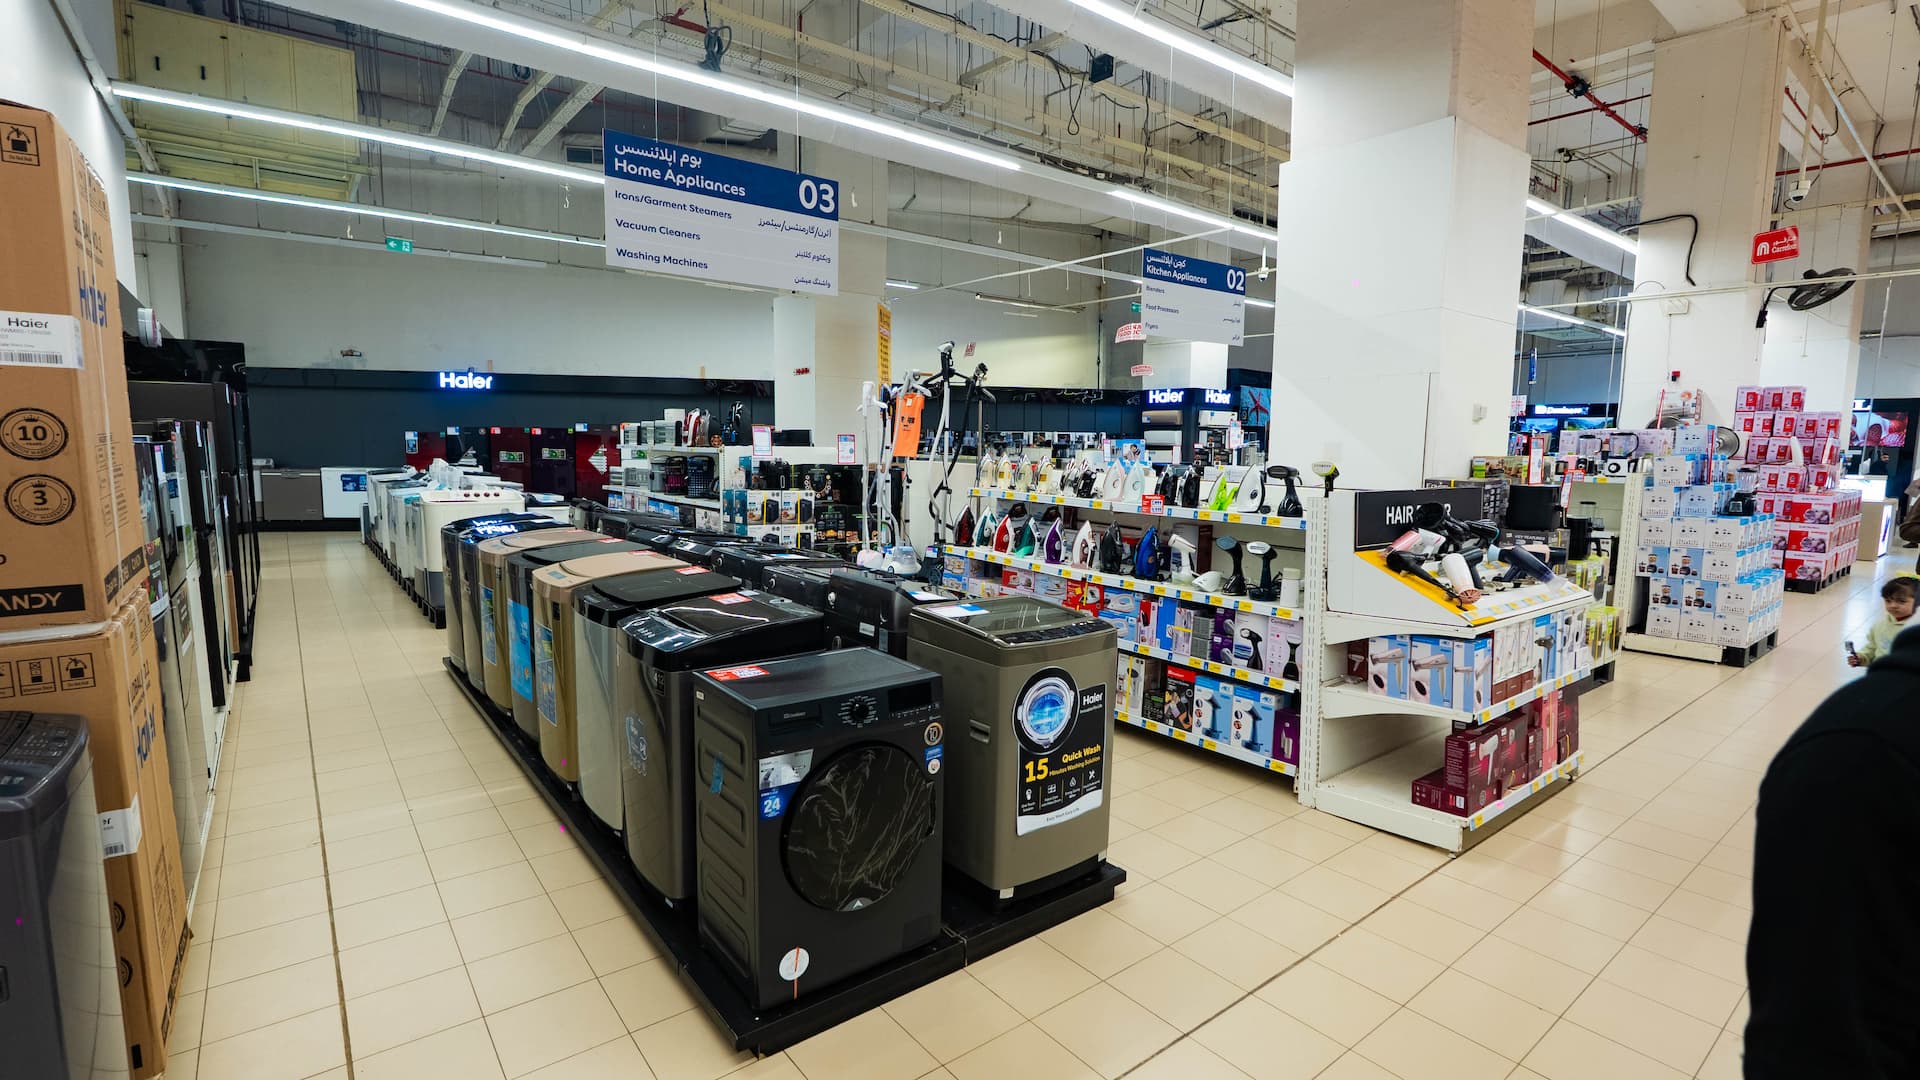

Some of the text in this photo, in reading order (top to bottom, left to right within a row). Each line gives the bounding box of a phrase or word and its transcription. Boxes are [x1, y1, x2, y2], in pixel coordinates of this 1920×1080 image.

[615, 158, 746, 197] Home Appliances
[615, 190, 732, 220] Irons/Garment Steamers
[799, 179, 836, 213] 03
[615, 218, 701, 241] Vacuum Cleaners
[616, 247, 708, 270] Washing Machines
[1146, 264, 1208, 284] Kitchen Appliances
[1226, 269, 1245, 291] 02
[1145, 303, 1157, 311] Food
[8, 317, 49, 329] Haier
[439, 371, 493, 389] Haier
[1148, 389, 1184, 404] Haier
[1205, 389, 1232, 404] Haier
[17, 425, 48, 441] 10
[33, 490, 48, 506] 3
[1386, 505, 1414, 526] HAIR
[1083, 692, 1104, 706] Haier
[1062, 744, 1101, 763] Quick Wash
[1025, 757, 1049, 783] 15
[1049, 756, 1101, 776] Minutes Washing Solution
[763, 798, 782, 815] 24
